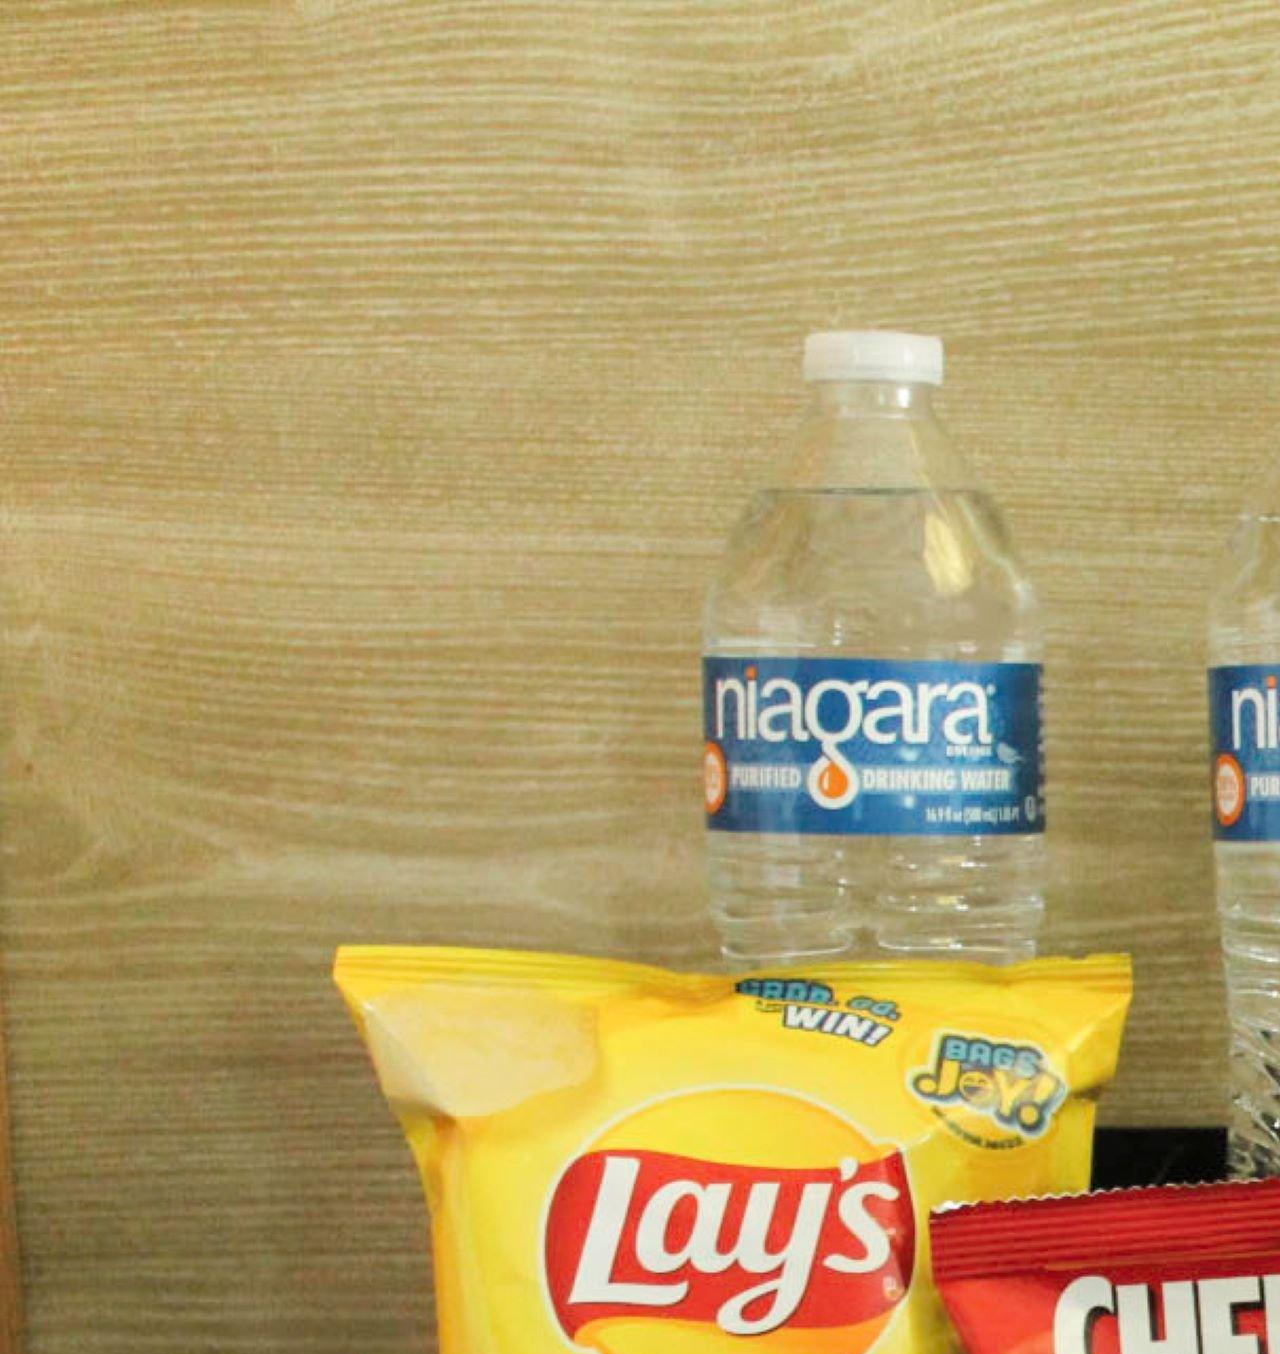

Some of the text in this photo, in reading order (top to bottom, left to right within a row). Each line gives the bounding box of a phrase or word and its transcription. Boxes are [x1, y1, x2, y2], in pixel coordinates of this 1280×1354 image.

[716, 665, 994, 784] niagara
[731, 765, 802, 788] PURIFIED
[862, 767, 1011, 790] DRINKING WATER
[784, 1004, 893, 1046] WIN!
[943, 1036, 1042, 1078] BAGS
[568, 1156, 900, 1335] Lay's
